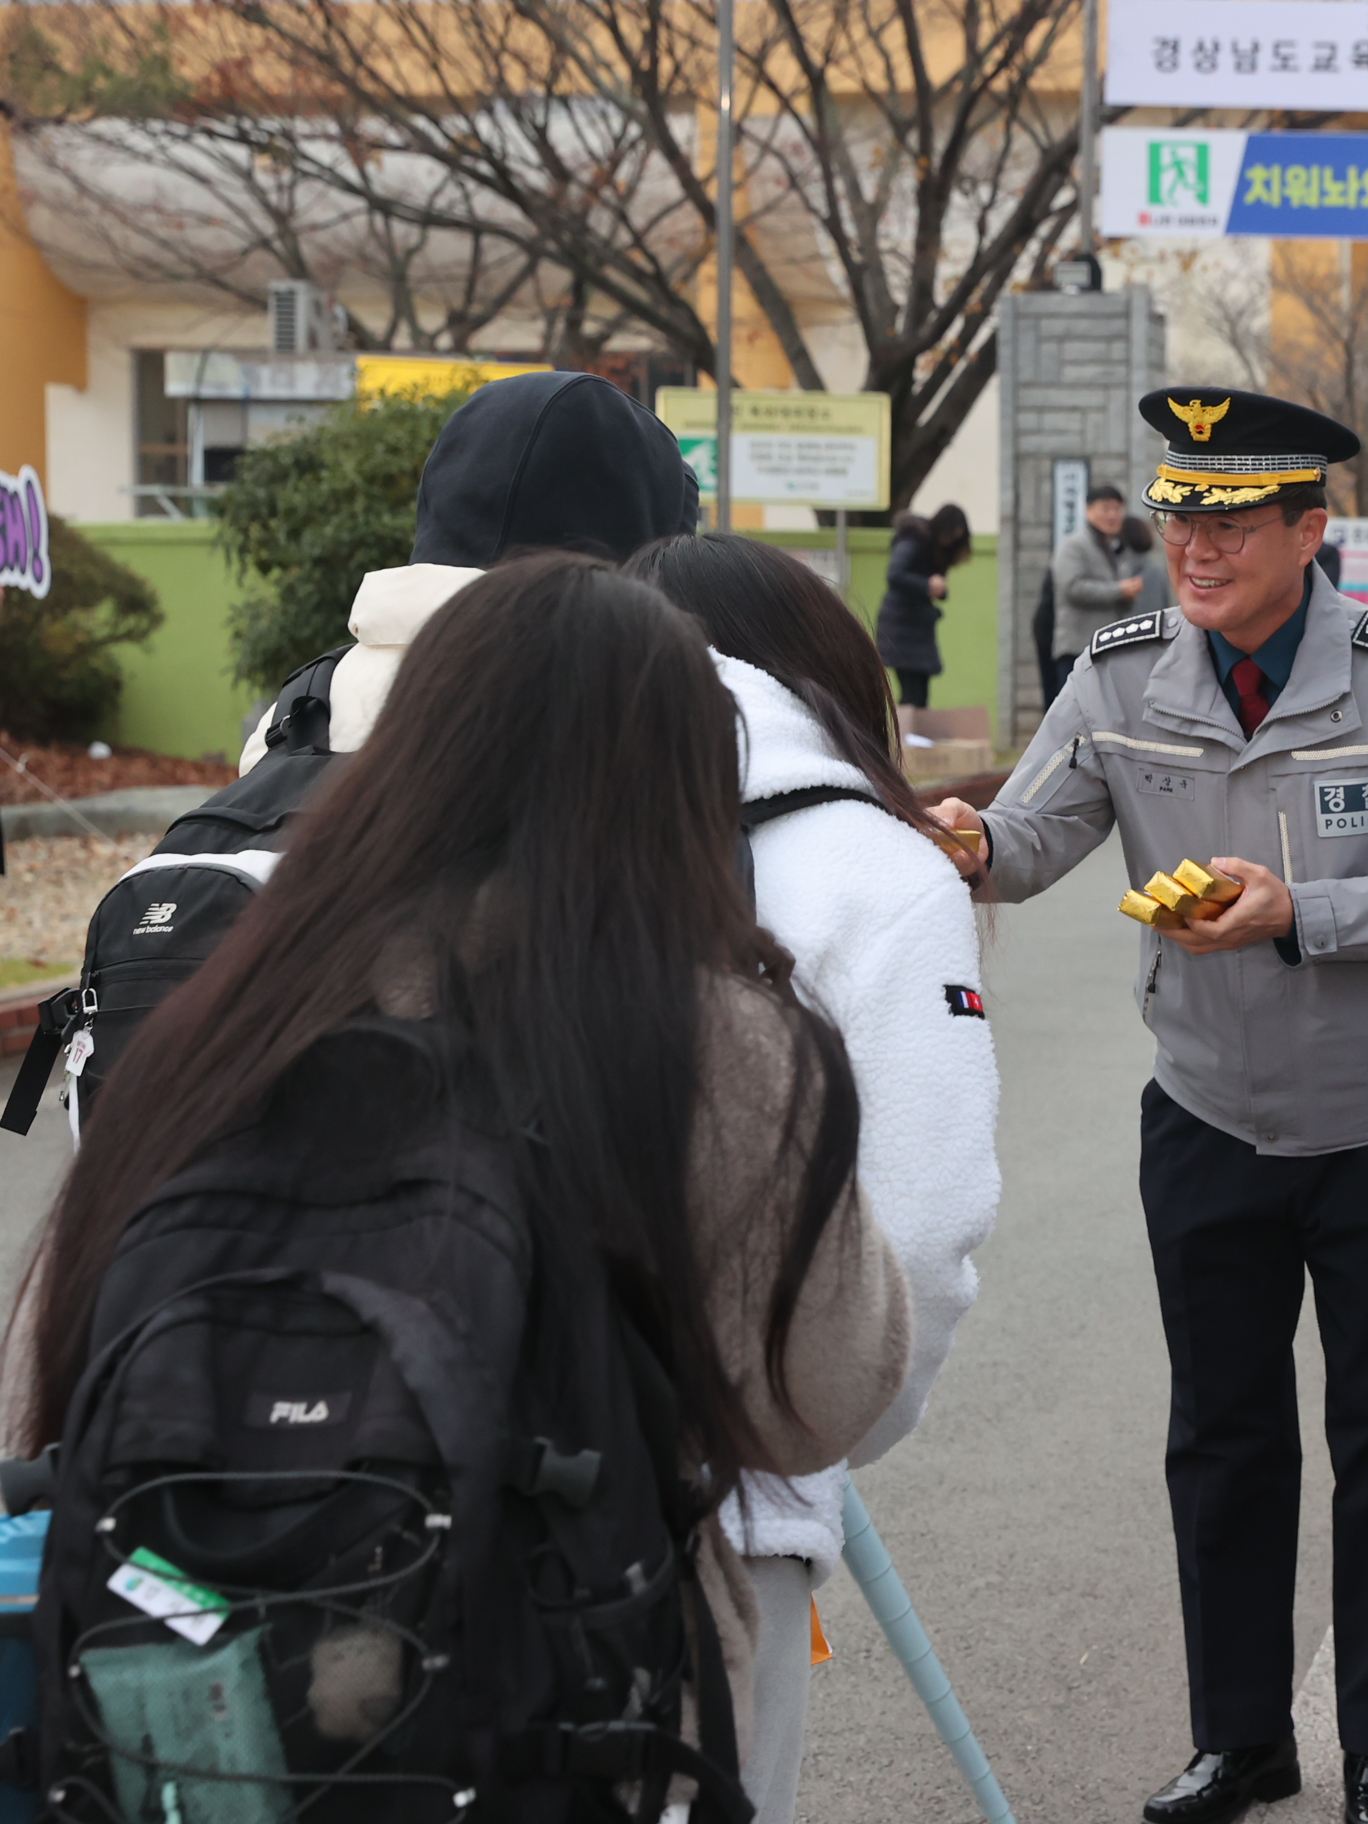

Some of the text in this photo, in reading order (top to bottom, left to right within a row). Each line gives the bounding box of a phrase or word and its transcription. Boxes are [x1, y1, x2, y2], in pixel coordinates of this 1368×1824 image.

[133, 925, 174, 935] new balance
[269, 1400, 329, 1424] FILA
